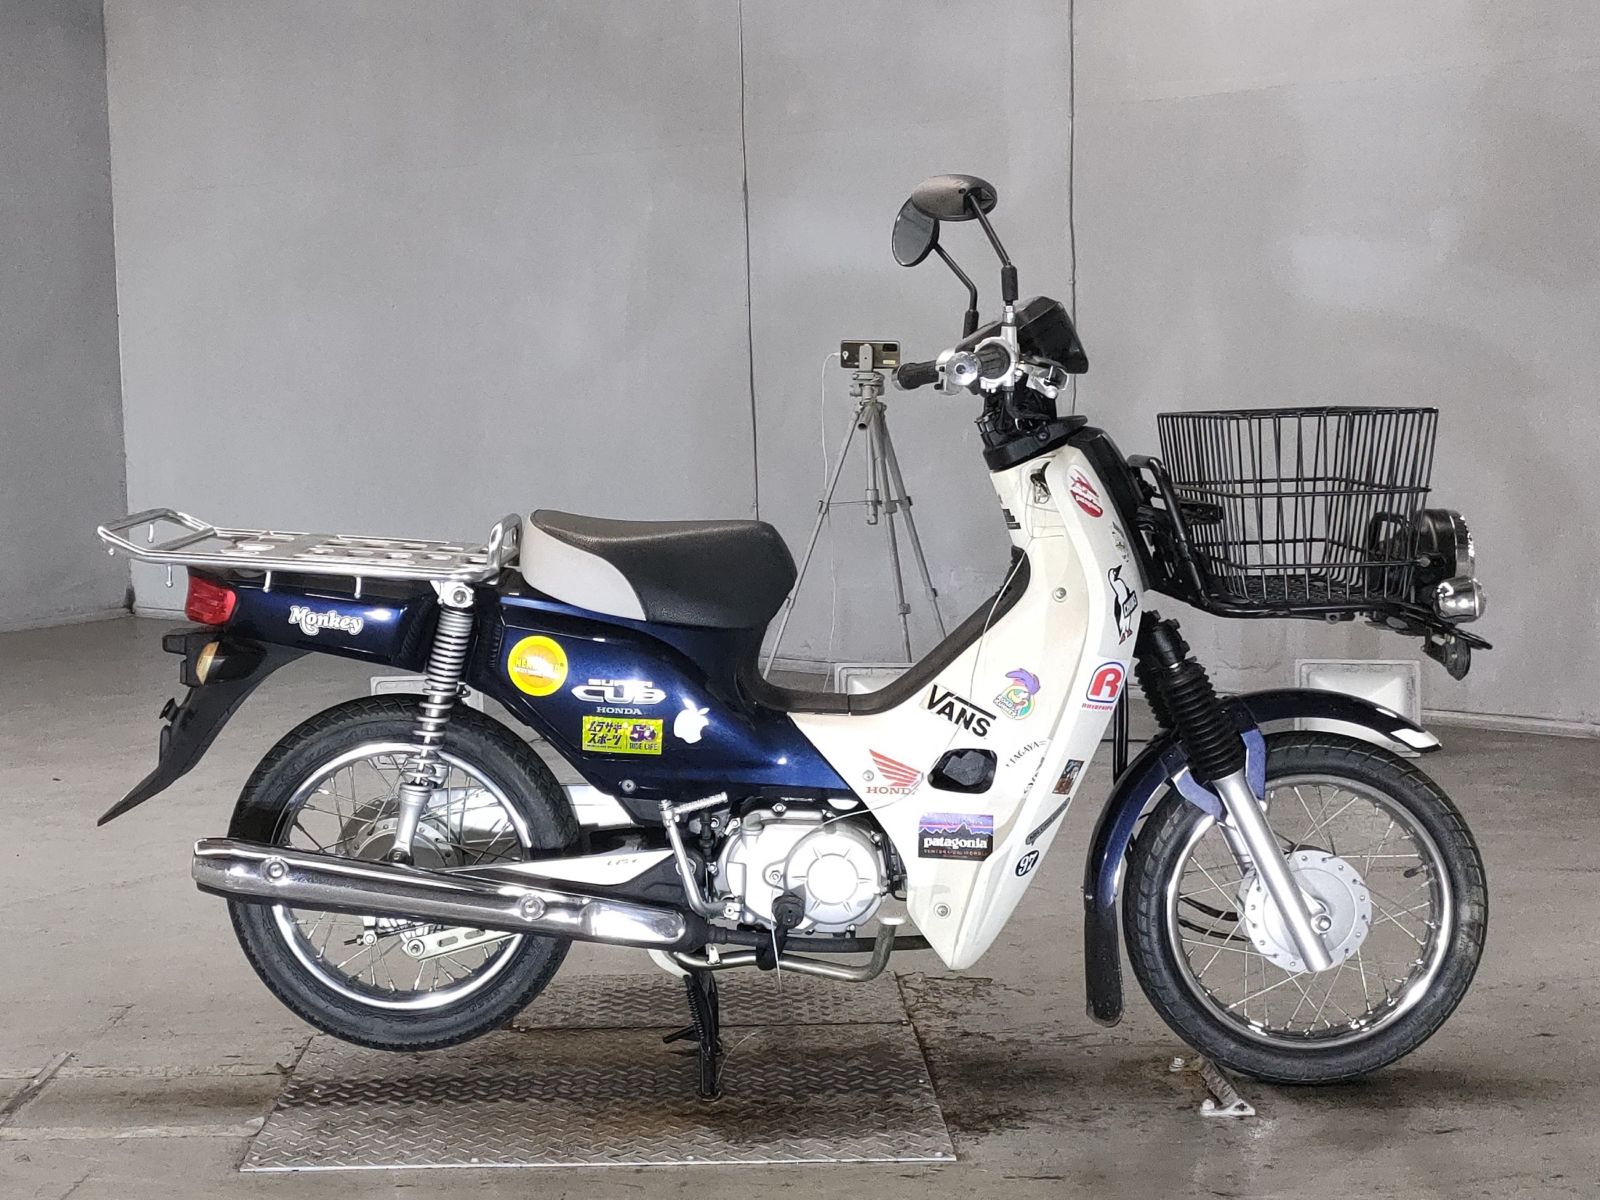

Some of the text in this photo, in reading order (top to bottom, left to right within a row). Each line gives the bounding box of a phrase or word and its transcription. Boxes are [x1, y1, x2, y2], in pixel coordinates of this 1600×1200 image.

[289, 605, 364, 636] Monkey
[1090, 667, 1121, 698] R
[597, 706, 643, 715] HONDA
[928, 684, 997, 738] VANS
[588, 720, 622, 733] ムラサキ
[587, 733, 623, 746] スポーツ
[923, 837, 988, 850] patagonia
[1017, 852, 1039, 876] 97
